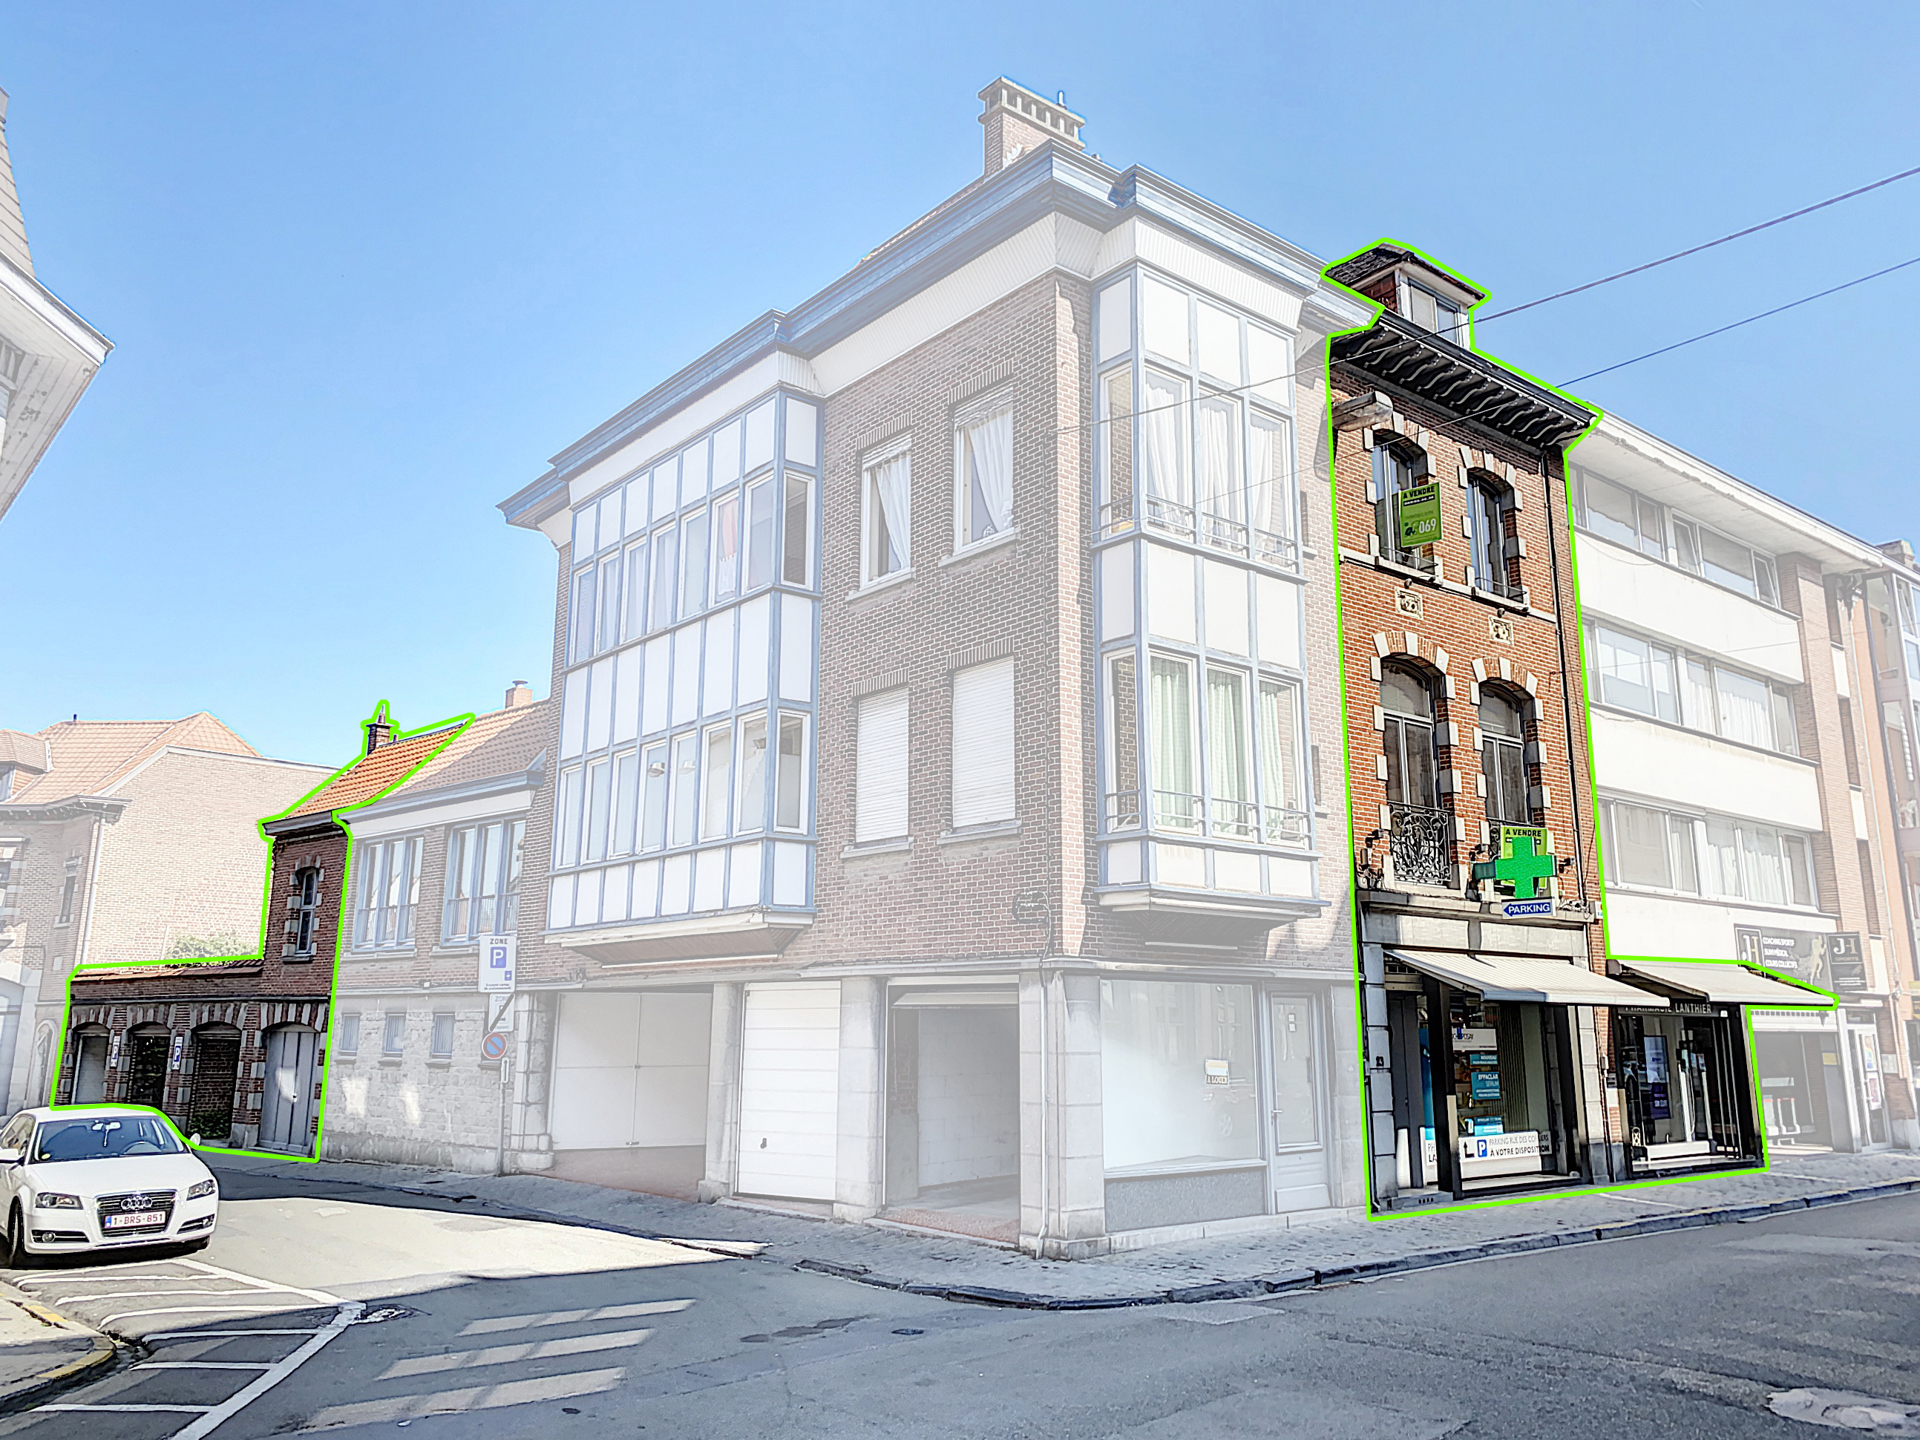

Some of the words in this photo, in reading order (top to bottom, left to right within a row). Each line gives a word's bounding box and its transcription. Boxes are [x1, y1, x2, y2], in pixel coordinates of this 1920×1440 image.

[1409, 485, 1435, 498] VENDRE
[1418, 518, 1437, 534] 069
[1512, 828, 1542, 837] VENDRE
[1508, 903, 1551, 914] PARKING
[1674, 1002, 1712, 1014] LANTHIER
[1489, 1137, 1509, 1146] PARKING
[1496, 1147, 1514, 1156] VOTRE
